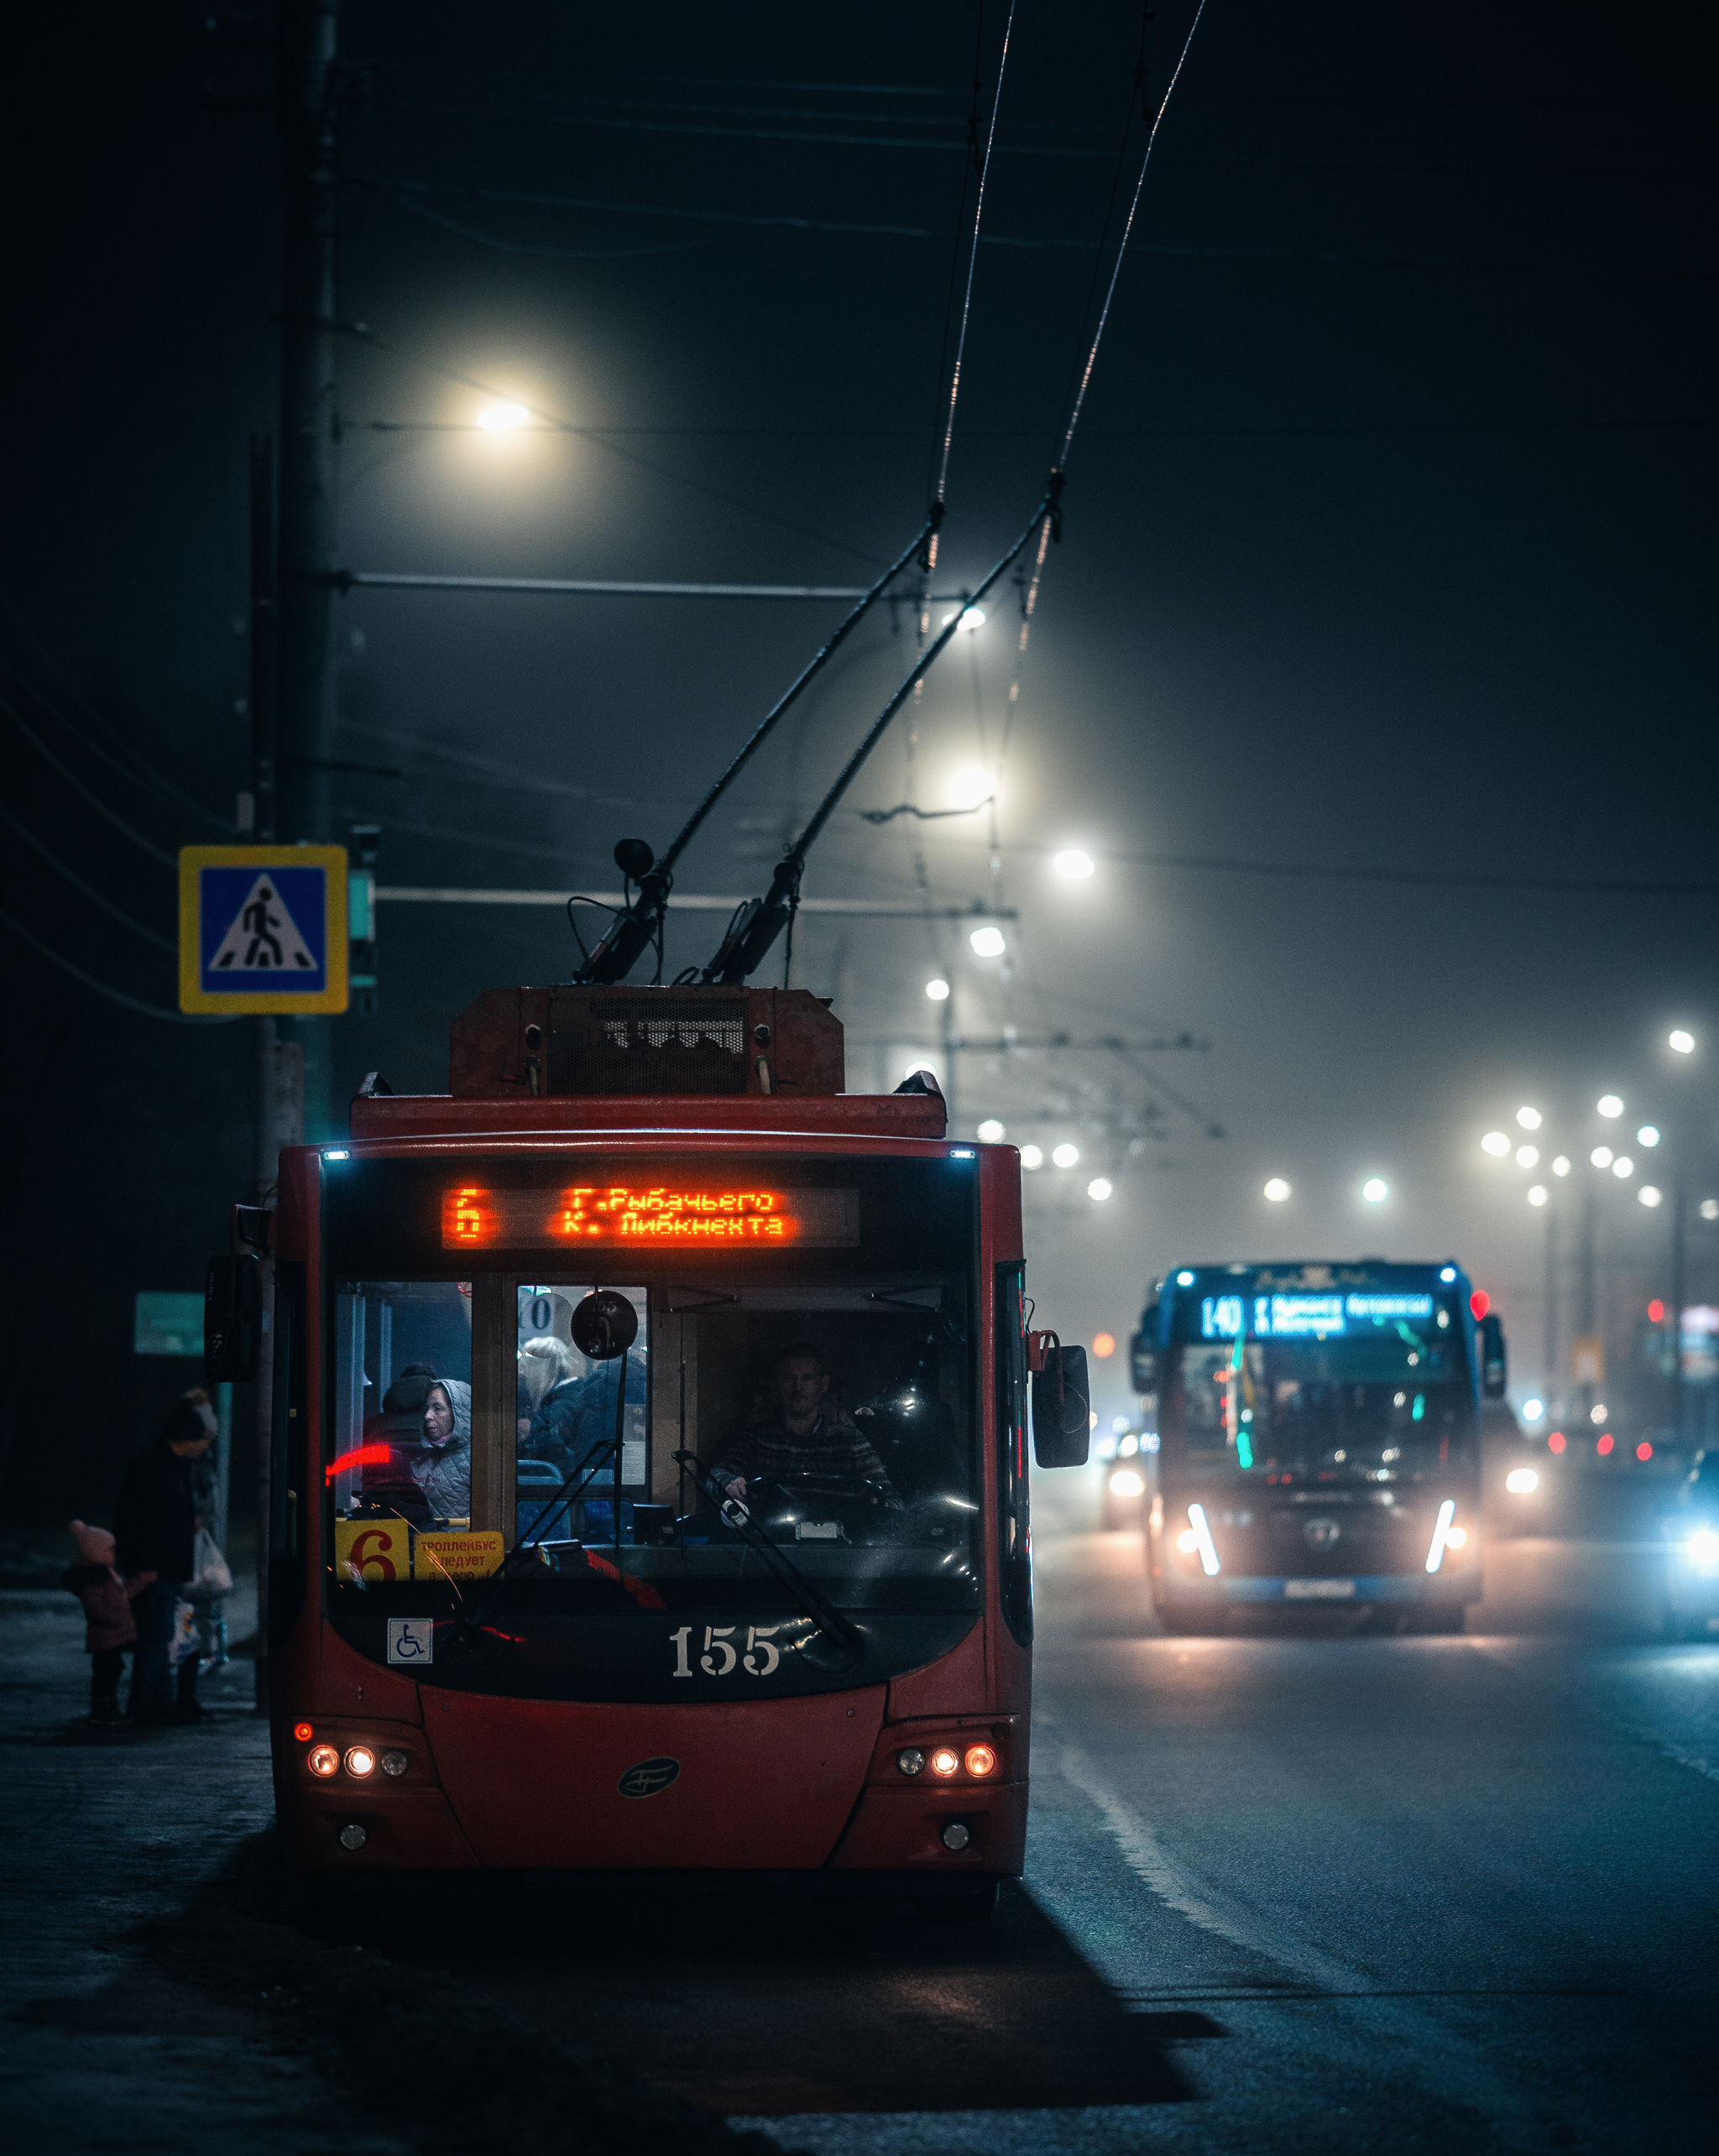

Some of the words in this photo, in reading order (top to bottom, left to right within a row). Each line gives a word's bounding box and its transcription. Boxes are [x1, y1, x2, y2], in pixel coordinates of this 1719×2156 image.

[457, 1188, 479, 1238] 6
[350, 1529, 396, 1581] 6
[669, 1626, 780, 1677] 155
